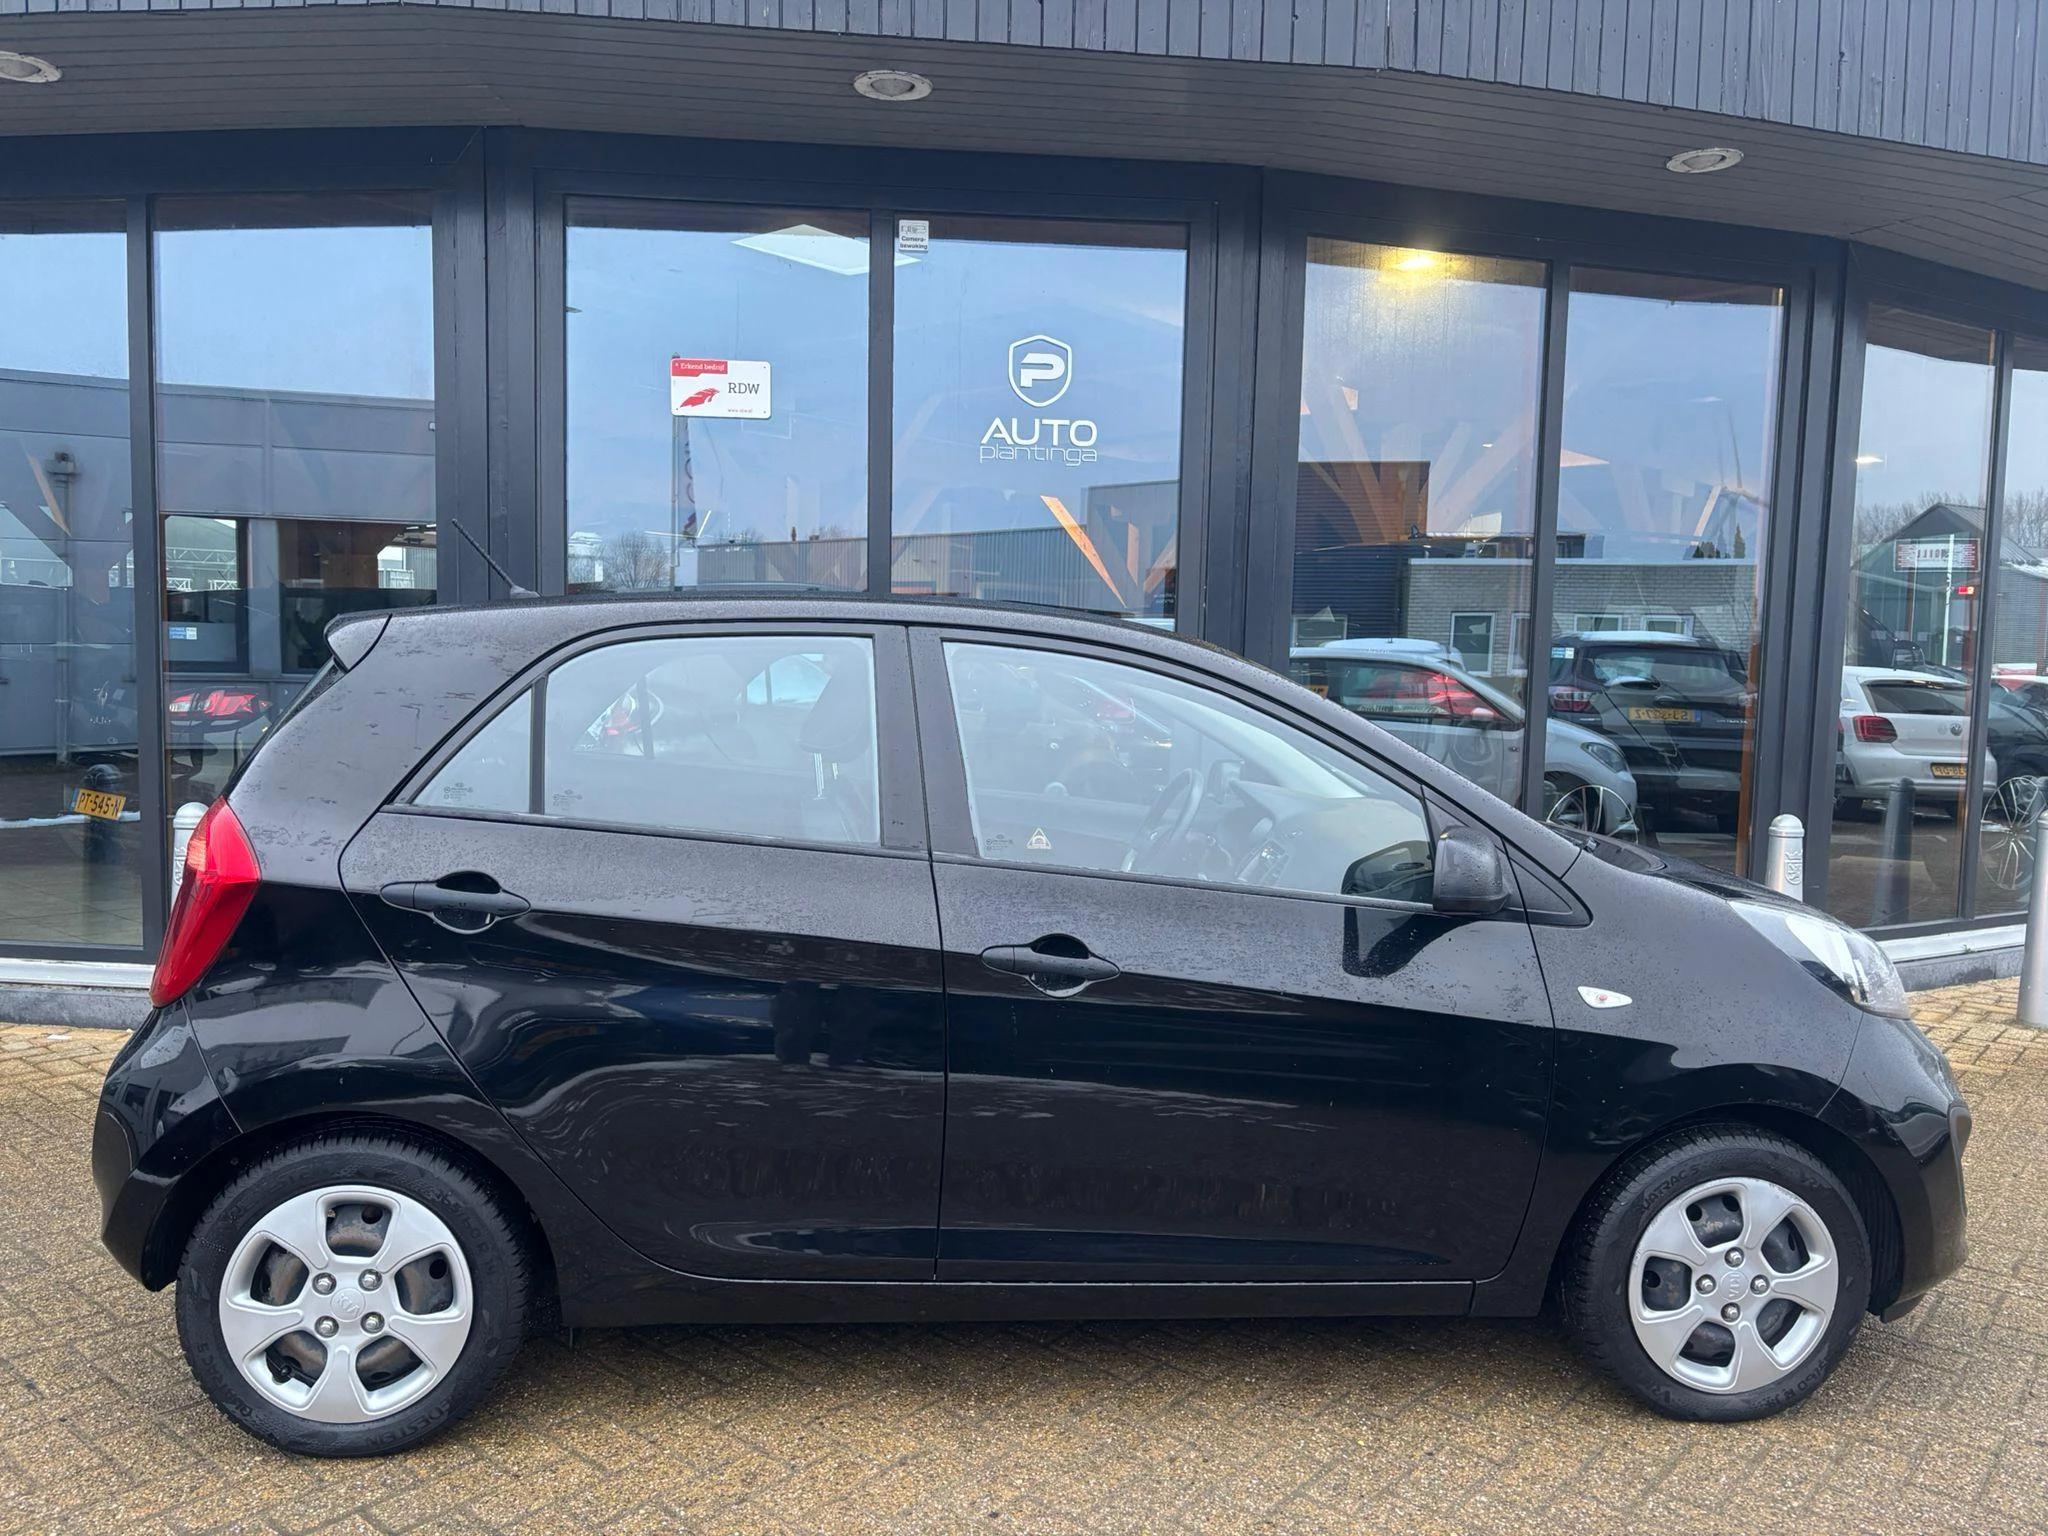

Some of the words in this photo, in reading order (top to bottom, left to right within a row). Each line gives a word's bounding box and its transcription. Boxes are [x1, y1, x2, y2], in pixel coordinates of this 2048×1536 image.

[728, 382, 760, 394] RDW
[980, 417, 1097, 446] AUTO
[980, 444, 1097, 466] plantinga
